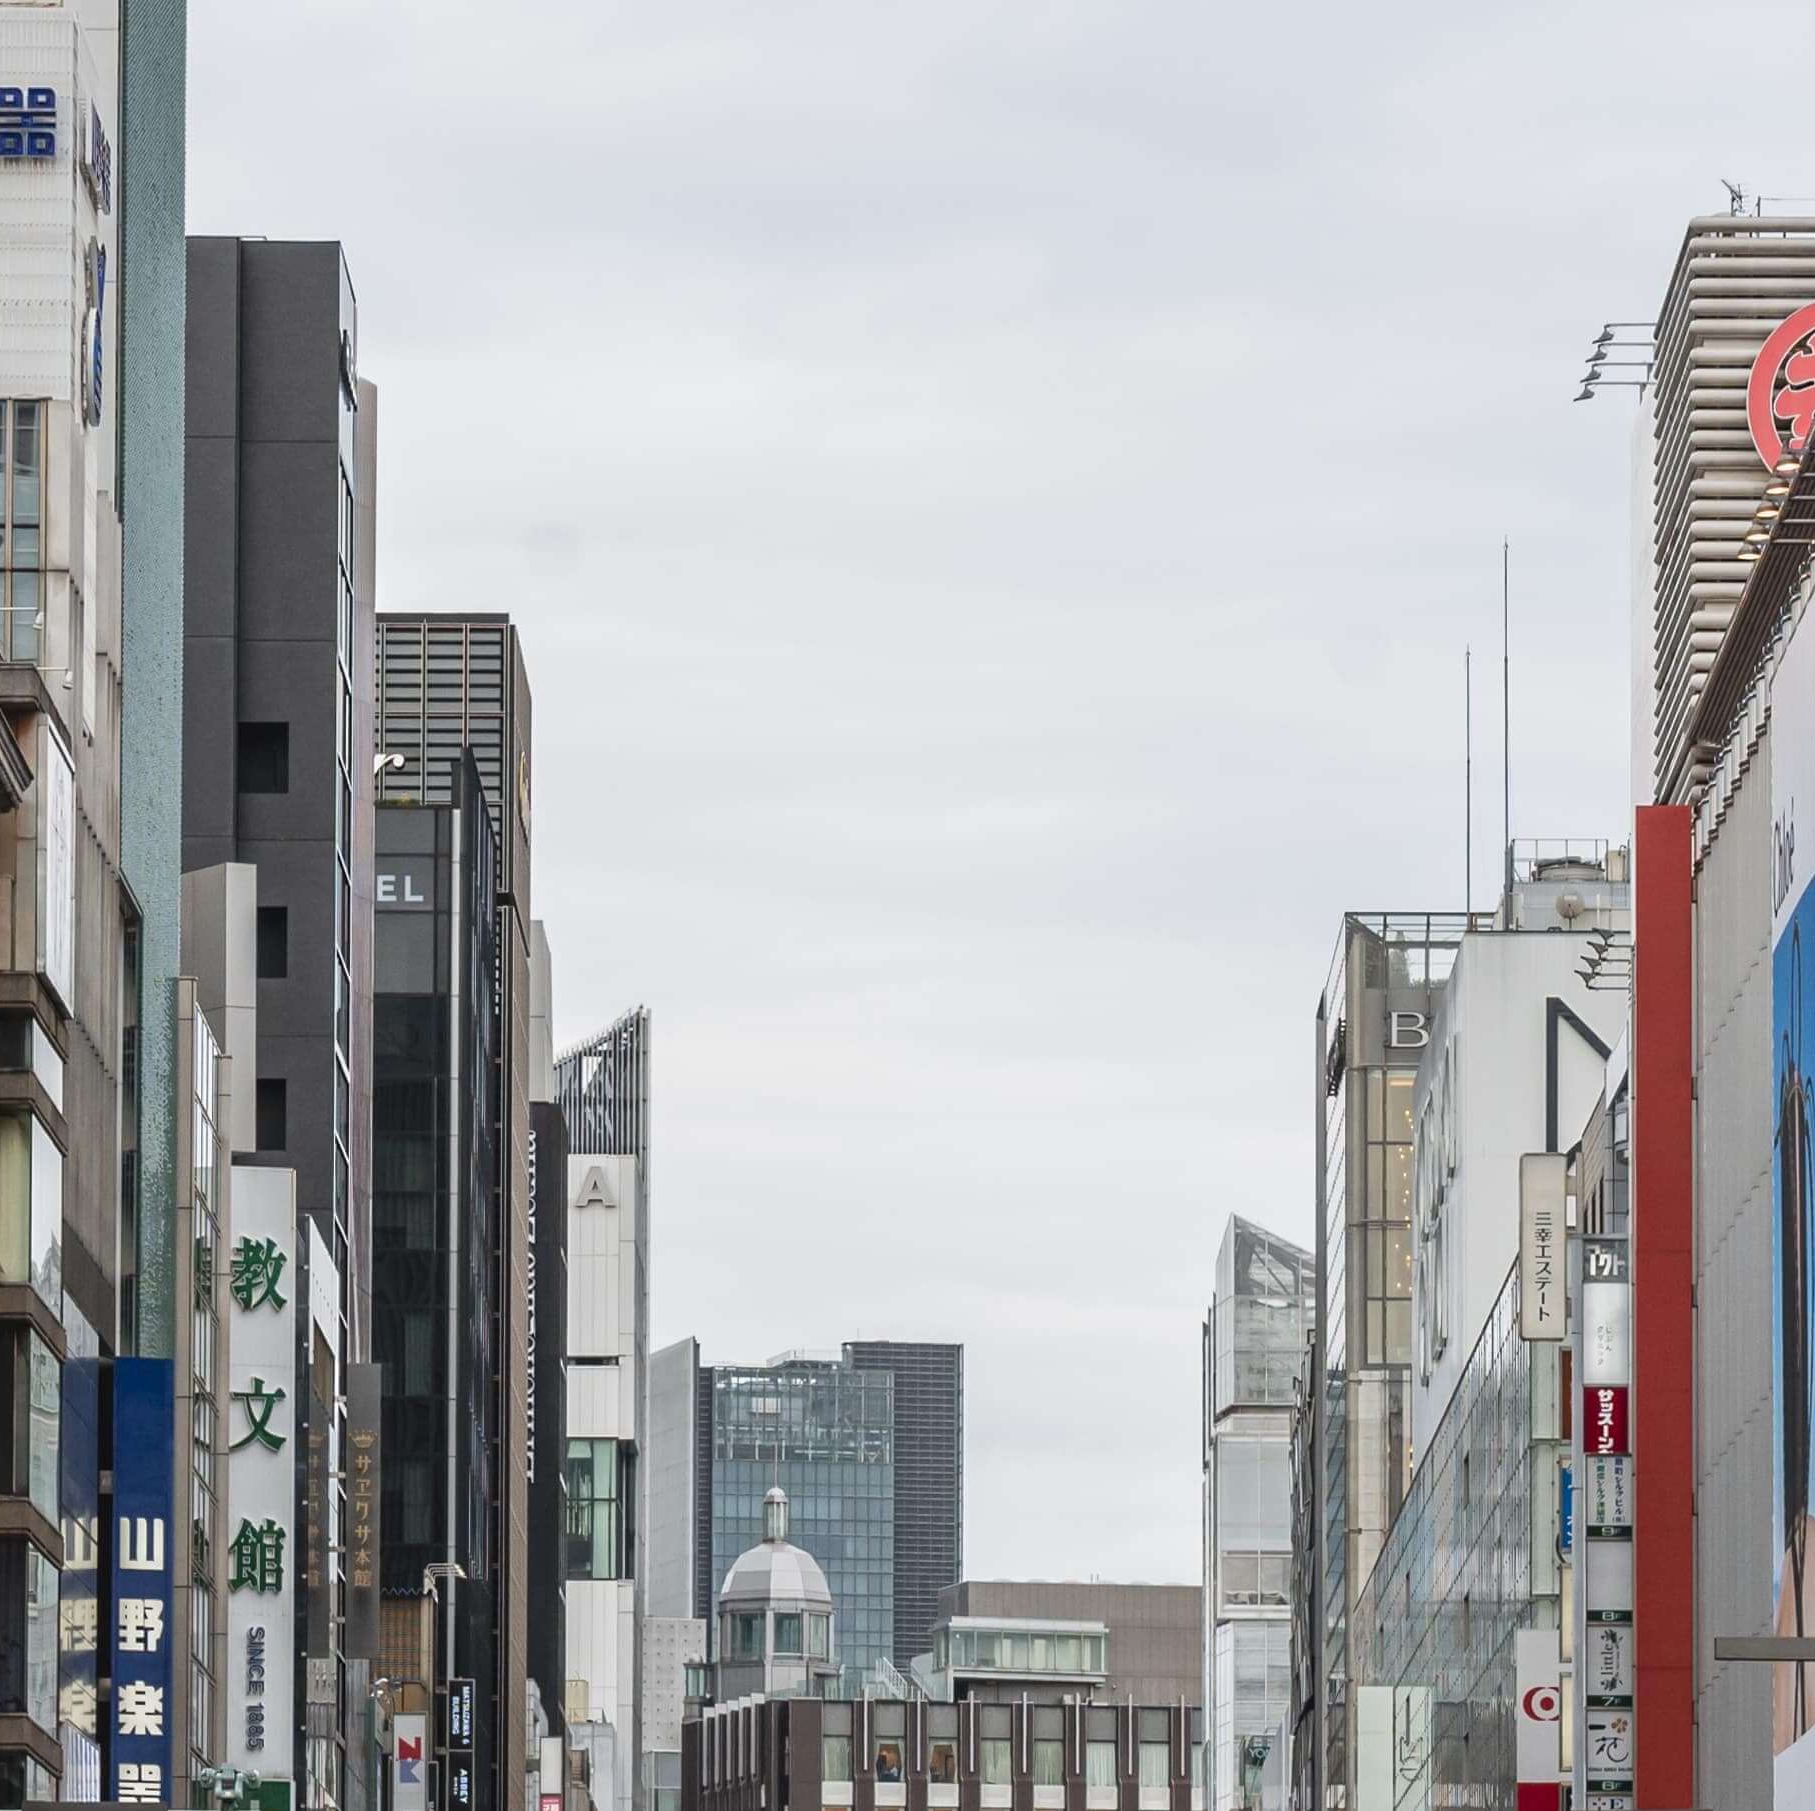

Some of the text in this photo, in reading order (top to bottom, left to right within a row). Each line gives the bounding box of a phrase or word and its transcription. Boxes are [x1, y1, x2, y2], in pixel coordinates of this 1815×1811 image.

[1535, 1212, 1552, 1321] 三幸エステート
[230, 1236, 287, 1593] 教文館
[118, 1518, 164, 1803] 山野楽器
[246, 1626, 265, 1752] SINCE 1885
